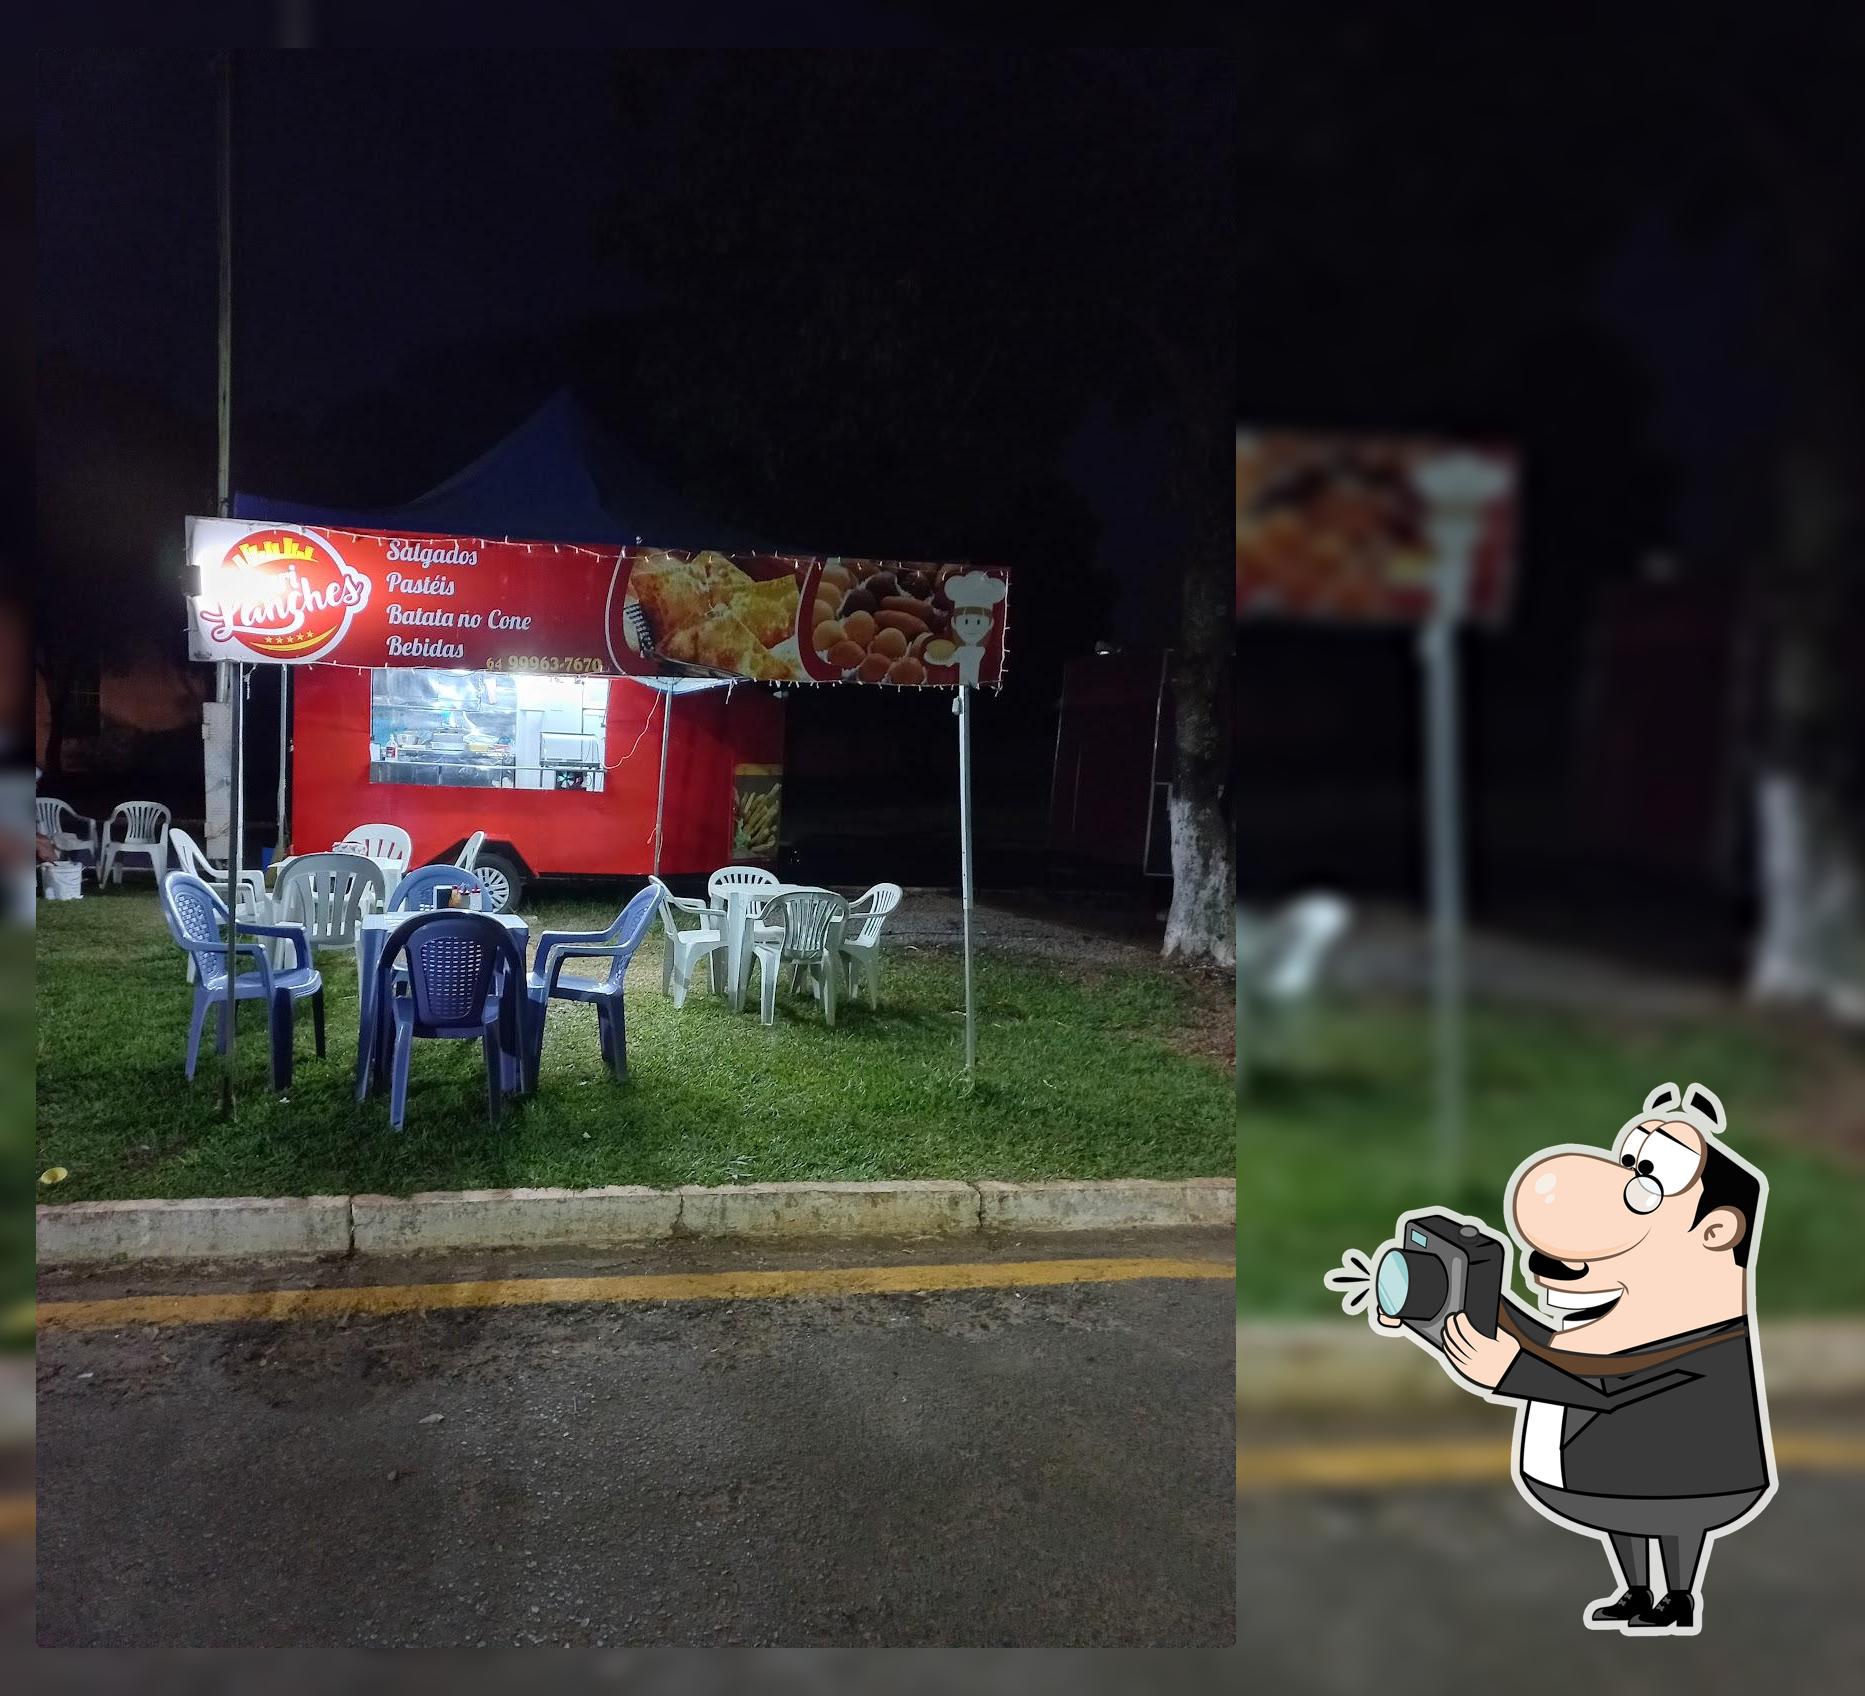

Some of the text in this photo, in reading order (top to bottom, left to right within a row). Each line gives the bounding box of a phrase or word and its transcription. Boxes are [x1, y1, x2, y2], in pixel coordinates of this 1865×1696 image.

[386, 539, 478, 568] Salgados
[386, 571, 456, 596] Pastéis
[200, 574, 364, 643] Lanches
[386, 603, 532, 631] Batata no Cone
[386, 635, 465, 659] Bebidas
[486, 655, 603, 673] 64 99963-7670
